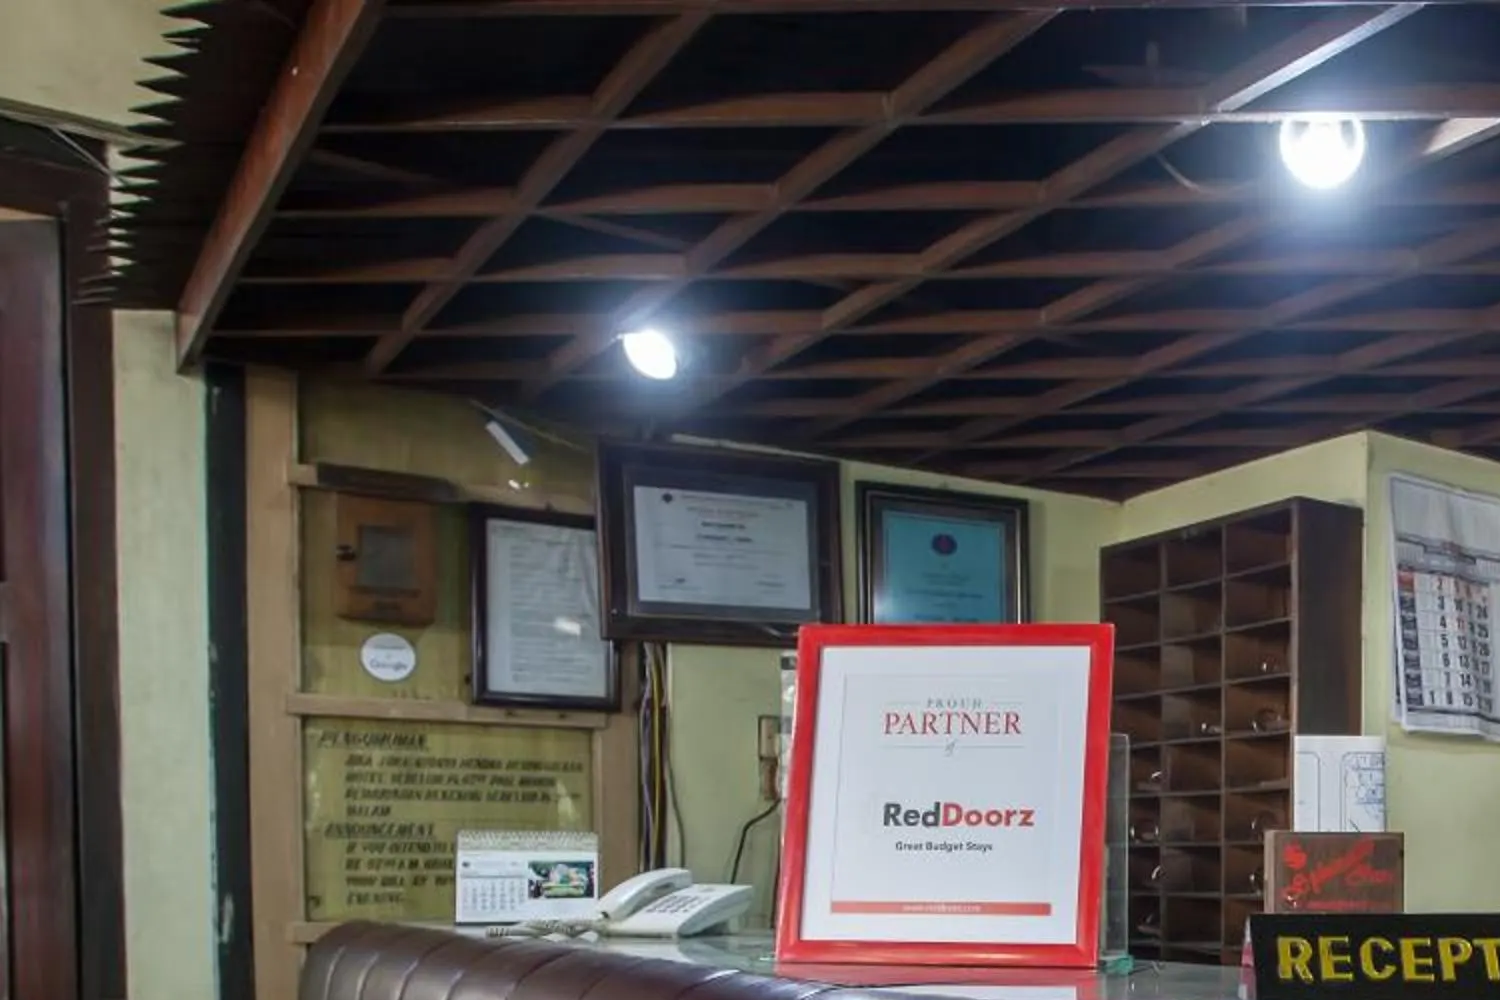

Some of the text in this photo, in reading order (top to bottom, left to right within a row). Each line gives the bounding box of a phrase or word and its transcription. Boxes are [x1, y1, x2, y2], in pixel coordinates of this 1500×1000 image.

[1439, 615, 1447, 629] 4
[883, 712, 1022, 735] PARTNER
[882, 802, 1035, 828] RedDoorz
[895, 841, 994, 853] Great Budget Stays
